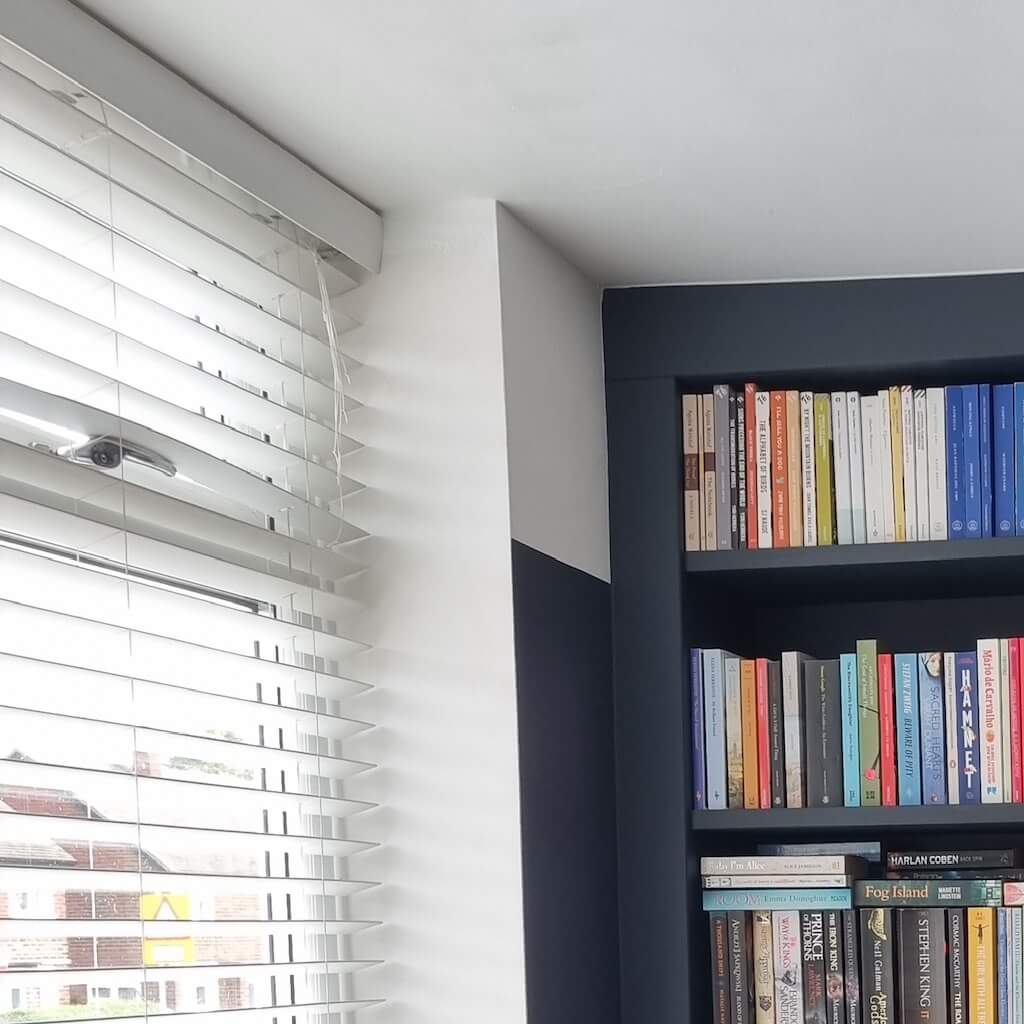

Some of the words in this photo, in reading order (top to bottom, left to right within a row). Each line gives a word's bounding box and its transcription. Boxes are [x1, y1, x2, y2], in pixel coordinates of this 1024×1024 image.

[761, 466, 767, 474] OF
[985, 677, 993, 687] de
[931, 687, 939, 730] SACRED
[986, 688, 995, 728] Carvalho
[932, 737, 941, 780] HEARTS
[891, 856, 928, 865] HARLAN
[929, 856, 958, 865] COBEN
[865, 886, 889, 901] Fog
[892, 886, 928, 898] Island
[804, 923, 812, 960] THORNS
[812, 914, 823, 960] PRINCE
[829, 928, 837, 948] IRON
[918, 919, 930, 973] STEPHEN
[920, 976, 931, 1007] KING
[870, 996, 880, 1024] Gods
[921, 1011, 928, 1020] IT
